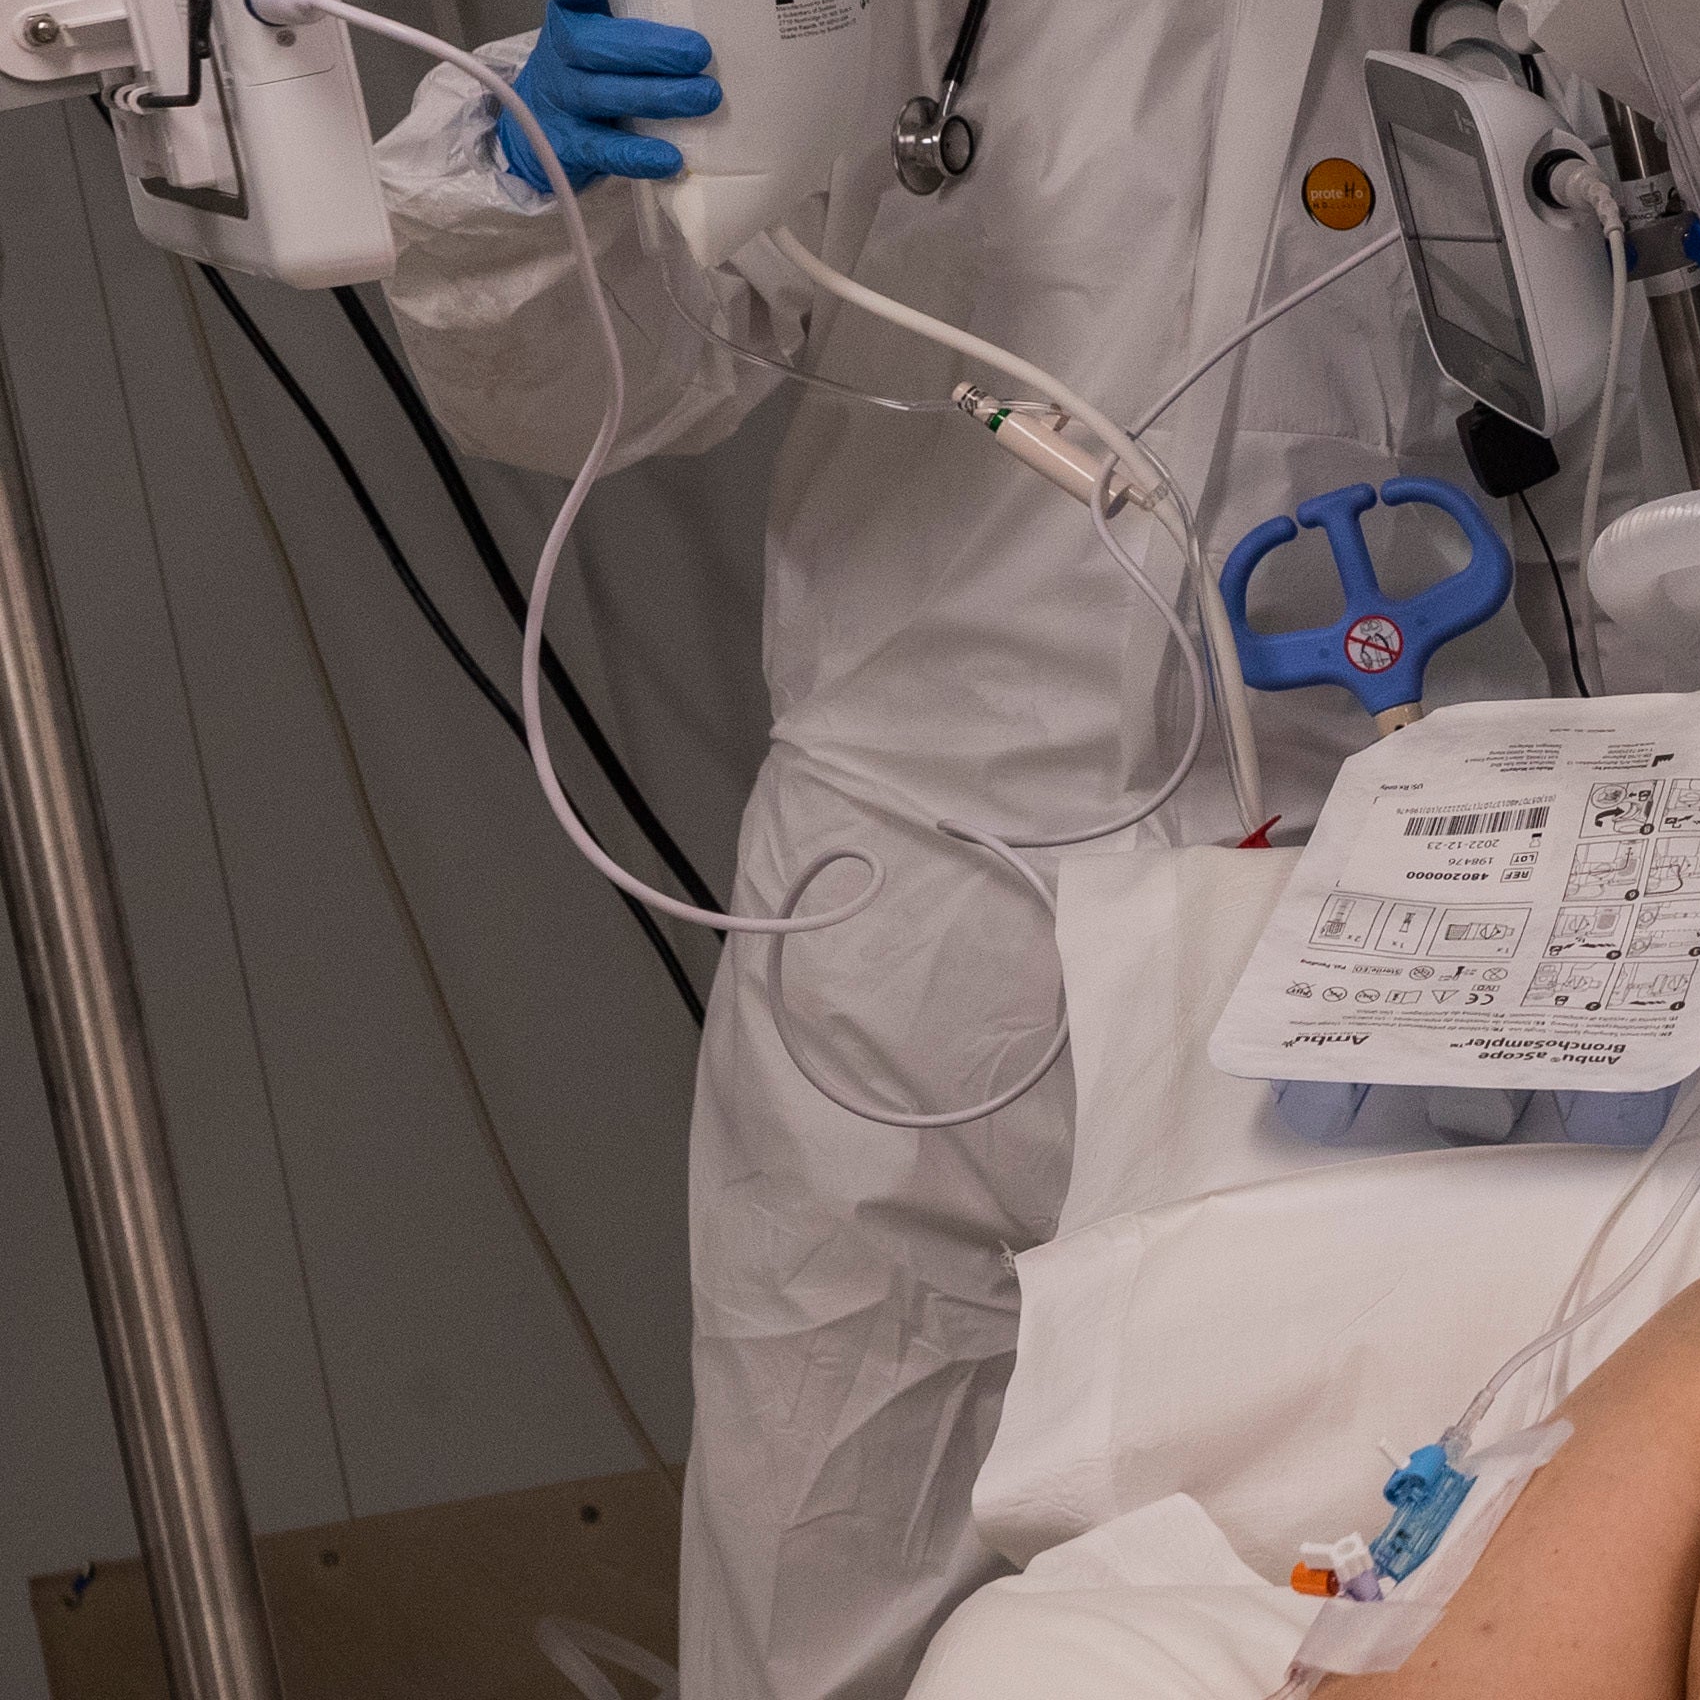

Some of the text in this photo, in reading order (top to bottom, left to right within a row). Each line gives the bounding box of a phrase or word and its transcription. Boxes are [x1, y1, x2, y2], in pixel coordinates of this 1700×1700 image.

[1426, 838, 1500, 850] 2022-12-23
[1447, 854, 1535, 867] LOT 198476
[1406, 871, 1530, 881] REF 480200000
[1294, 1034, 1370, 1046] Ambu
[1477, 1051, 1548, 1061] aScope
